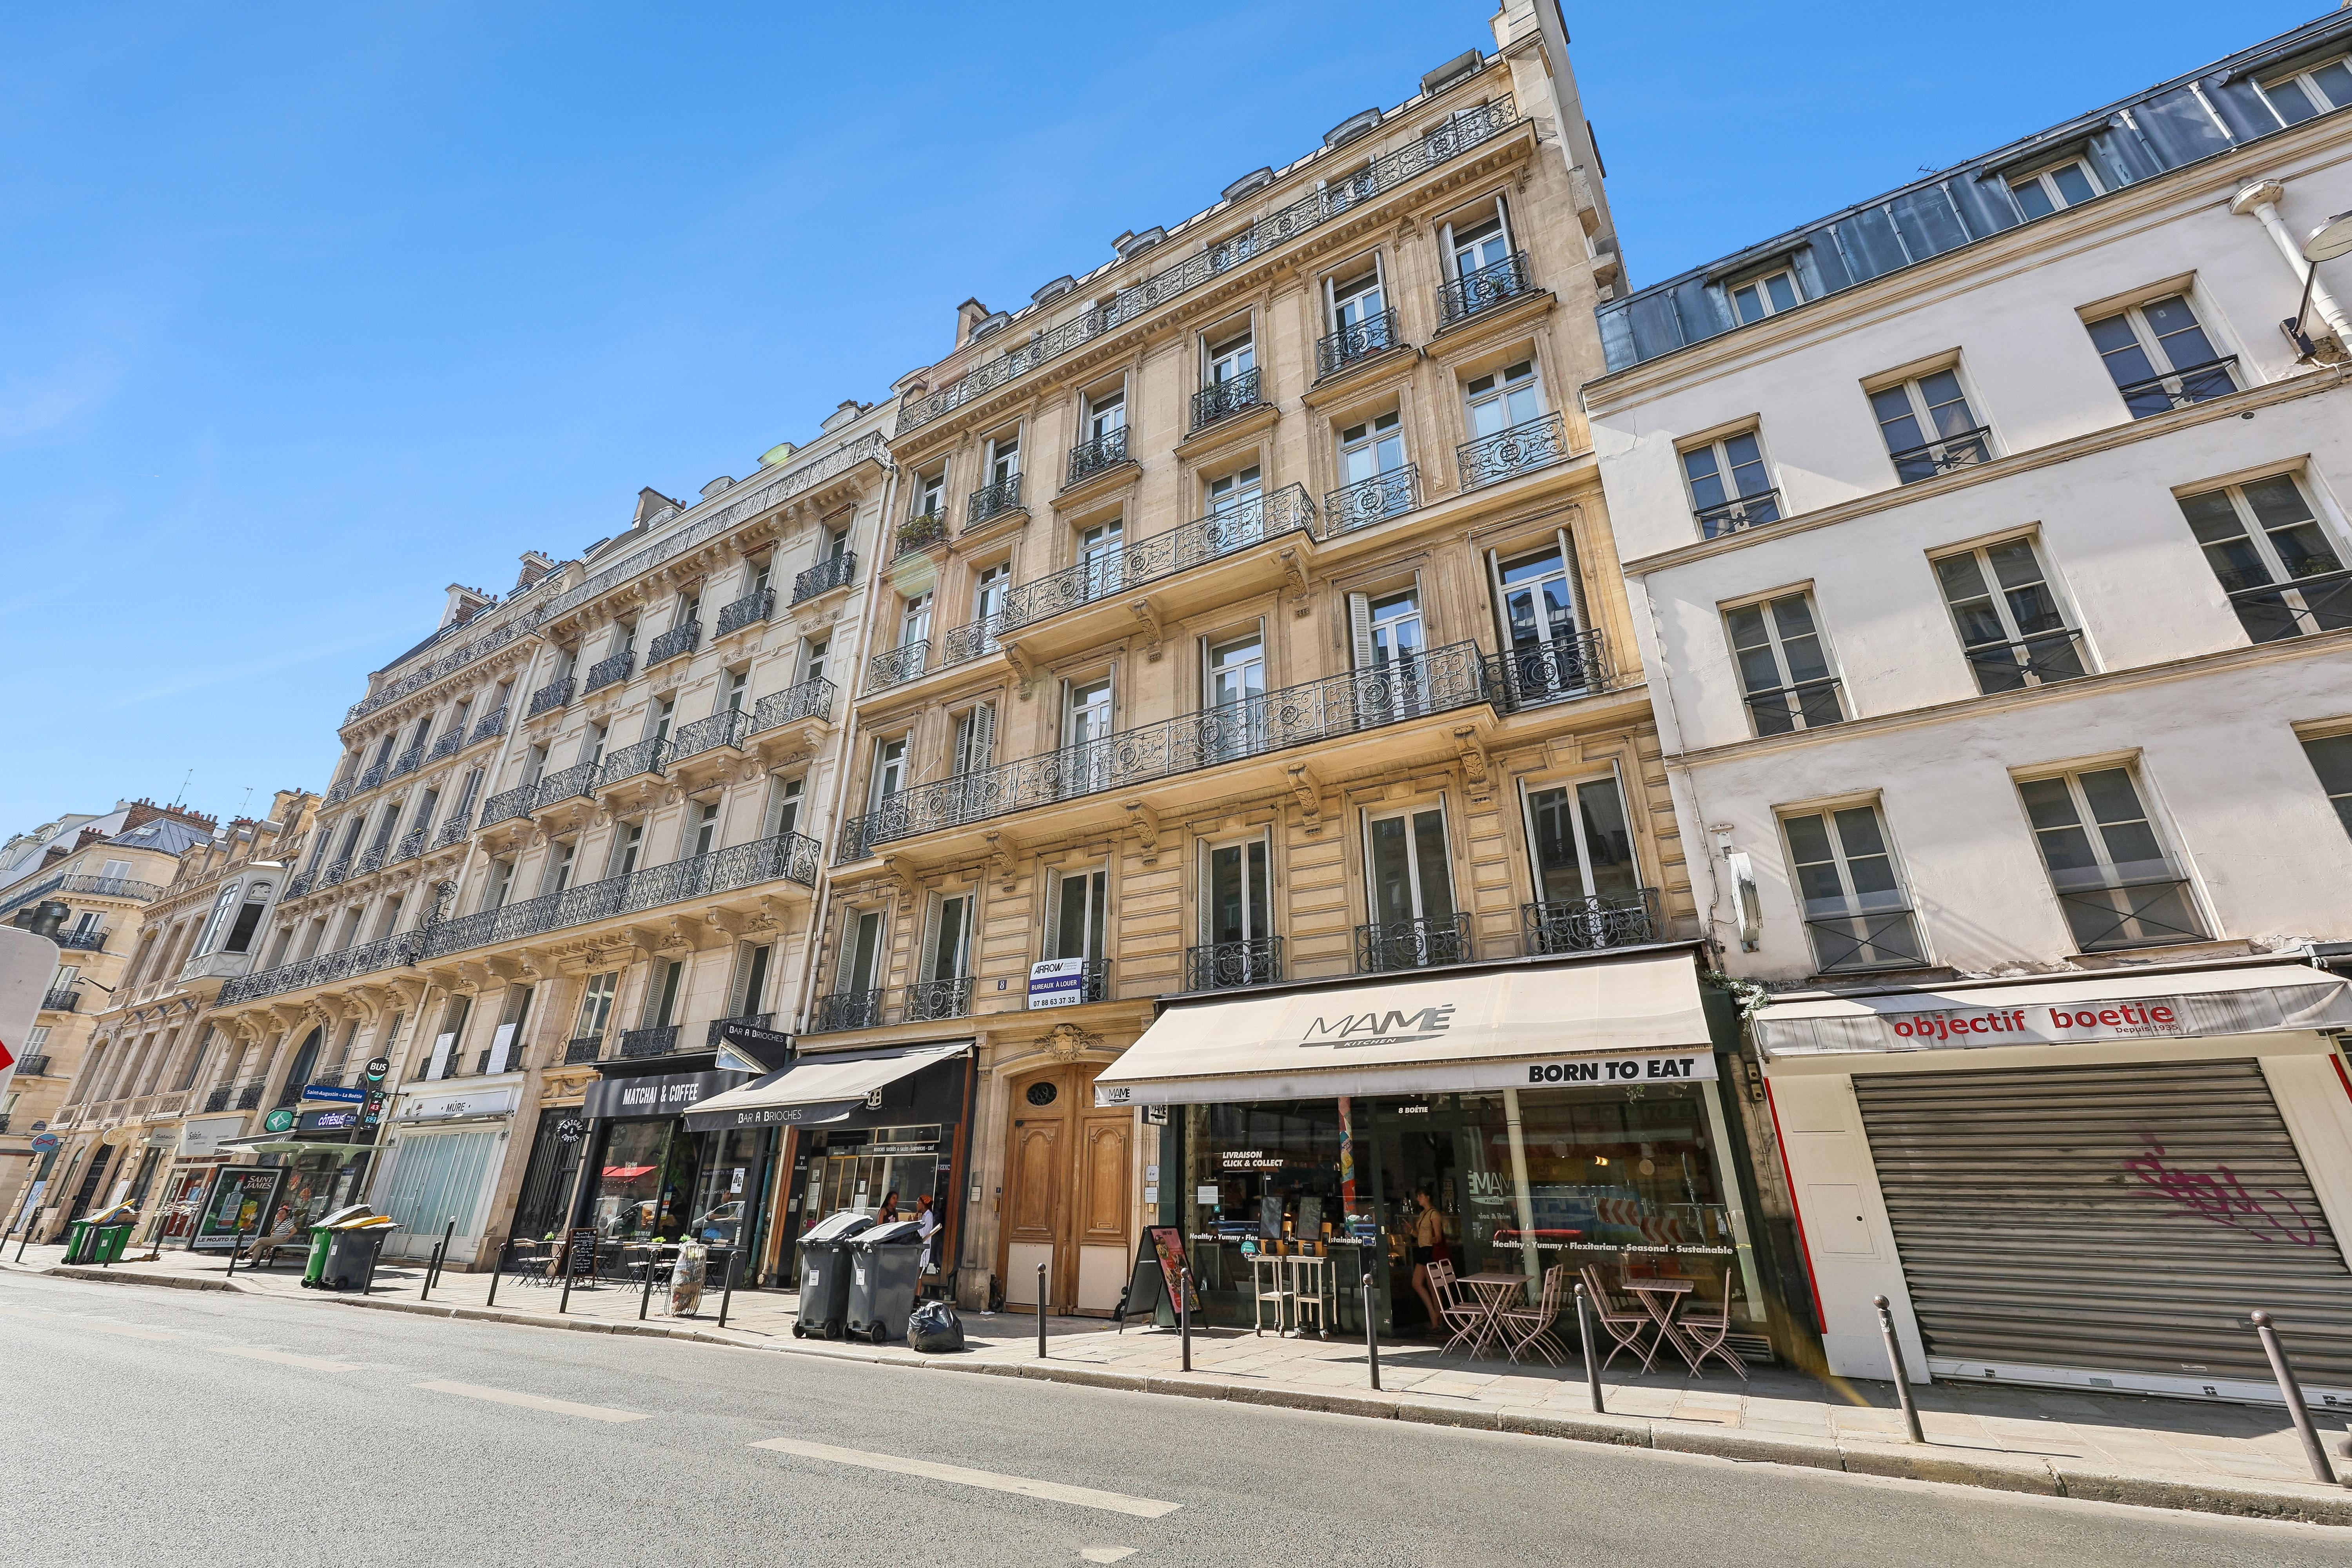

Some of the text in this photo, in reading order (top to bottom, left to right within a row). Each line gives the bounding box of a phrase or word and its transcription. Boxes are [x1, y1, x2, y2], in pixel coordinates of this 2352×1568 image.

[1034, 962, 1063, 975] ARROW
[1000, 980, 1004, 989] 8
[1302, 1004, 1456, 1040] MAMÉ
[1894, 1002, 2175, 1040] objectif boetie
[729, 1026, 742, 1035] BAR
[752, 1030, 783, 1042] BRIOCHES
[1343, 1038, 1397, 1047] KITCHEN
[1529, 1058, 1694, 1082] BORN TO EAT
[622, 1083, 699, 1105] MATCHAI & COFFEE
[1109, 1087, 1130, 1098] MAMÉ
[446, 1100, 466, 1112] MÛRE
[1405, 1105, 1428, 1113] BOÉTIE
[738, 1110, 802, 1124] BAR A BRIOCHES
[563, 1120, 583, 1130] MATCHAI
[561, 1134, 579, 1142] COFFEE
[1189, 1233, 1213, 1241] Healthy
[1493, 1240, 1733, 1254] Healthy Yummy Flexitarian Seasonal Sustainable
